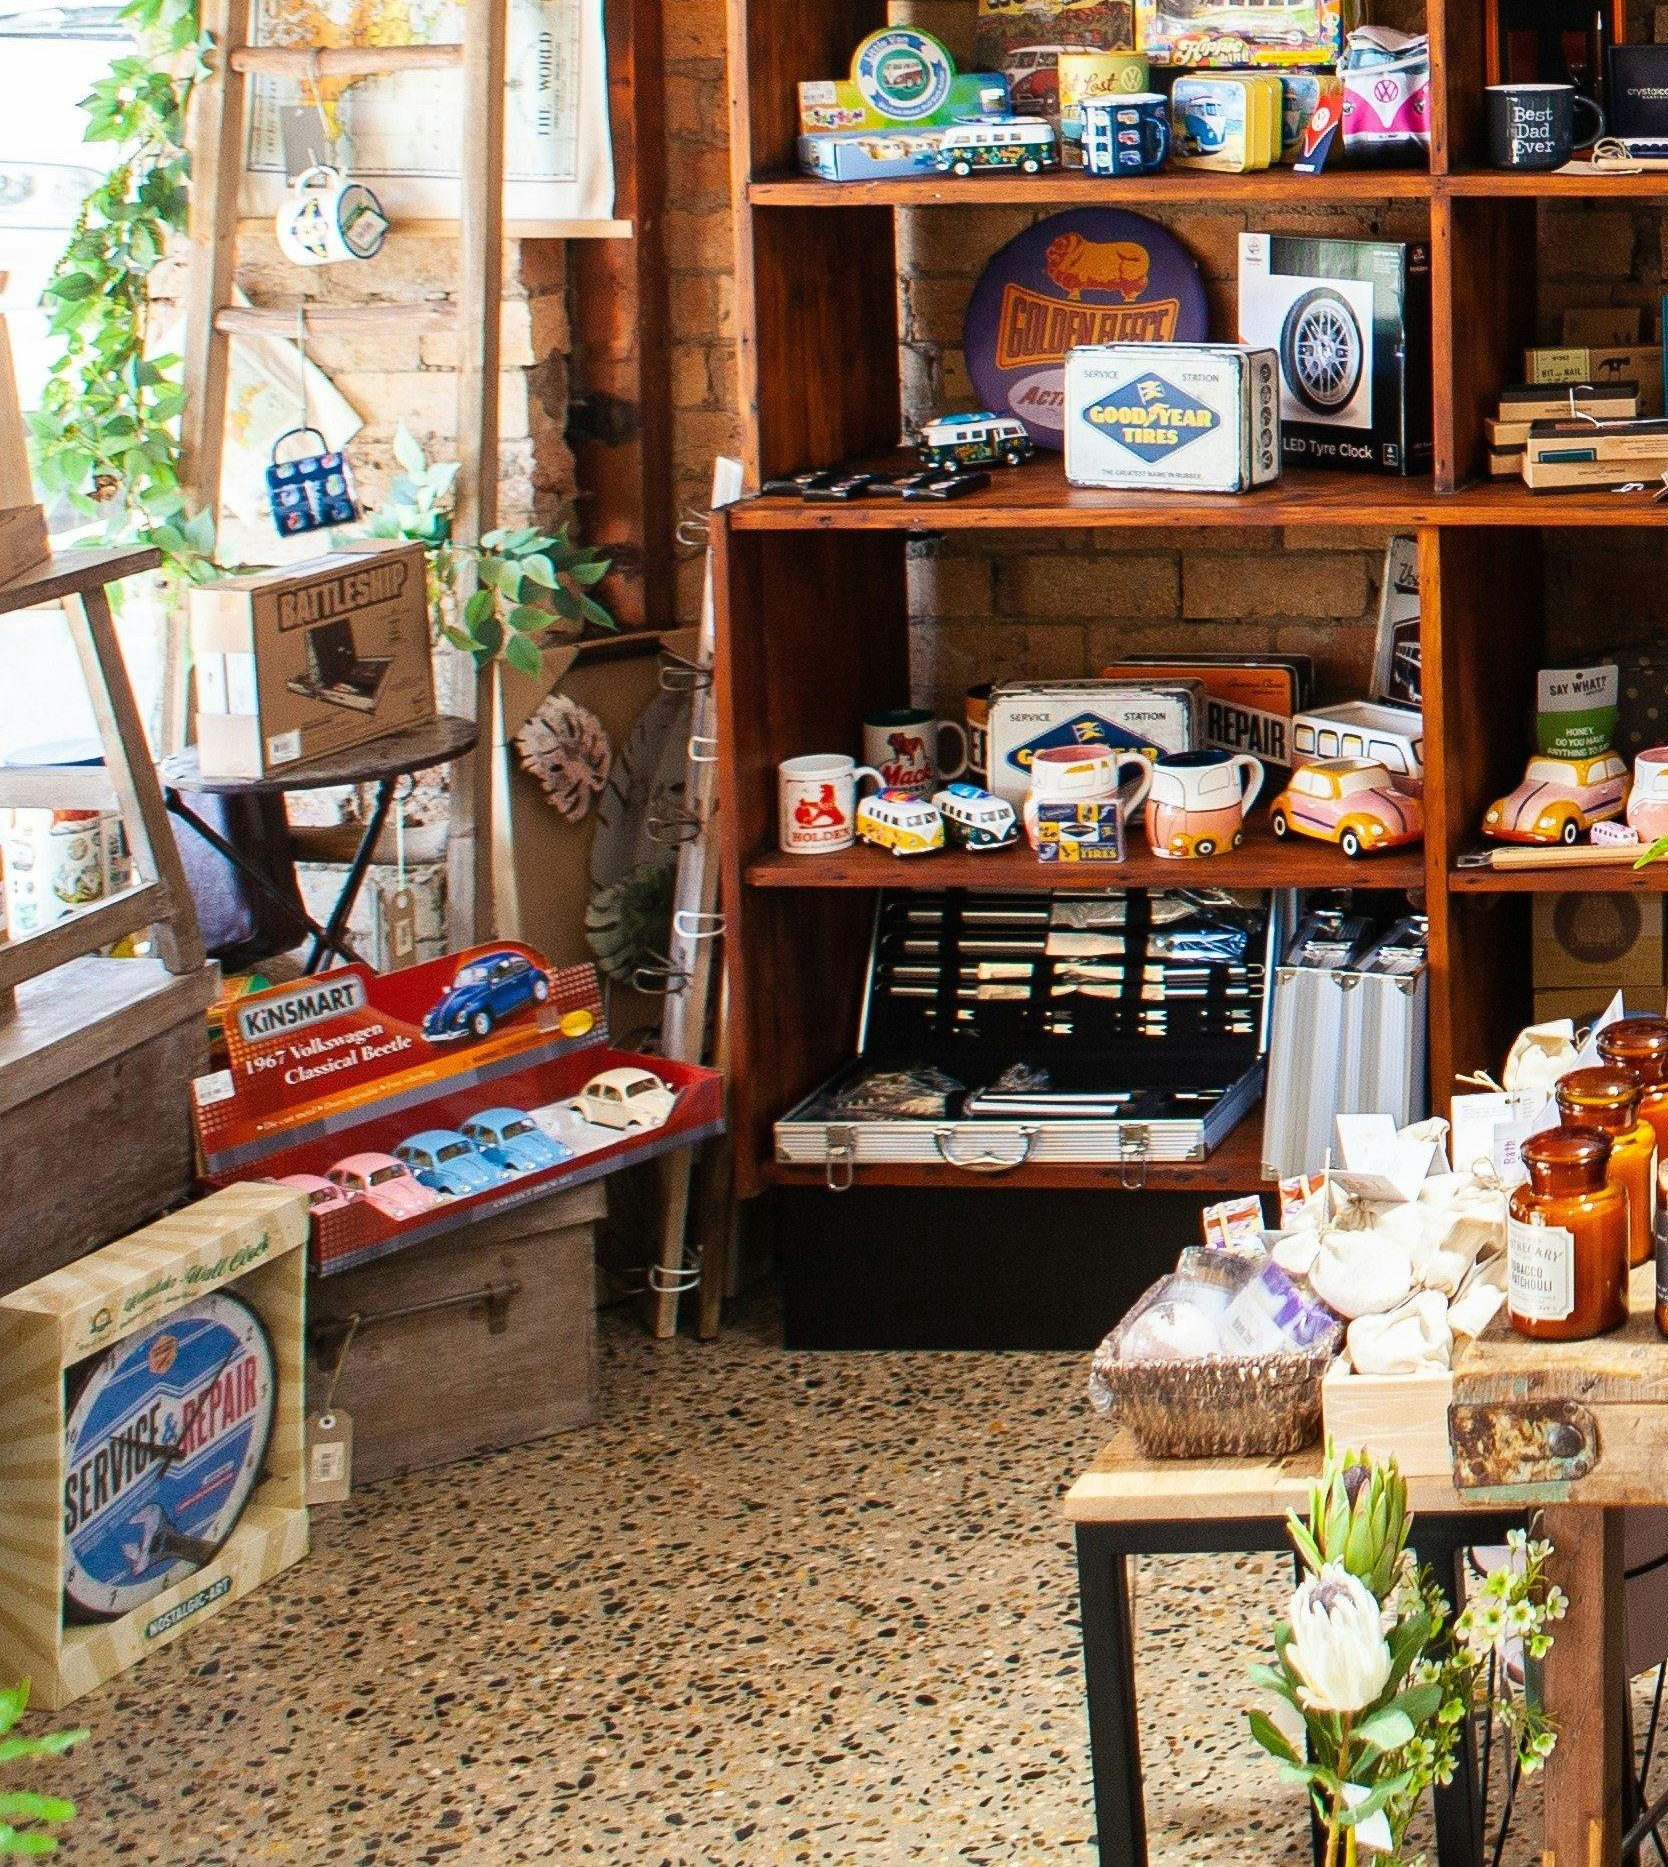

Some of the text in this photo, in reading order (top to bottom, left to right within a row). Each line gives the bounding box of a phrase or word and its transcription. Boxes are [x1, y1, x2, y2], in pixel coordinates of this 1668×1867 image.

[538, 31, 552, 135] THE WORLD
[1083, 75, 1117, 95] Lost
[1514, 106, 1554, 123] Best
[1516, 124, 1549, 138] Dad
[1514, 139, 1556, 155] Ever
[1008, 294, 1171, 358] GOLDEN FLEECE
[1083, 369, 1219, 383] SERVICE STATION
[1089, 404, 1214, 428] GOODYEAR
[1122, 428, 1178, 446] TIRES
[1283, 436, 1373, 460] LED Tyre Clock
[279, 561, 407, 631] BATTLESHIP
[1549, 675, 1606, 696] SAY WHAT?
[1009, 711, 1167, 722] SERVICE STATION
[1207, 707, 1285, 758] REPAIR
[1555, 737, 1585, 747] DO YOU
[882, 764, 933, 787] Mack
[246, 1024, 384, 1075] 1967 Volkswagen
[284, 1034, 413, 1085] Classical Beetle
[64, 1354, 258, 1529] SERVICE REPAIR
[148, 1578, 230, 1638] NOSTALGIC-ART
